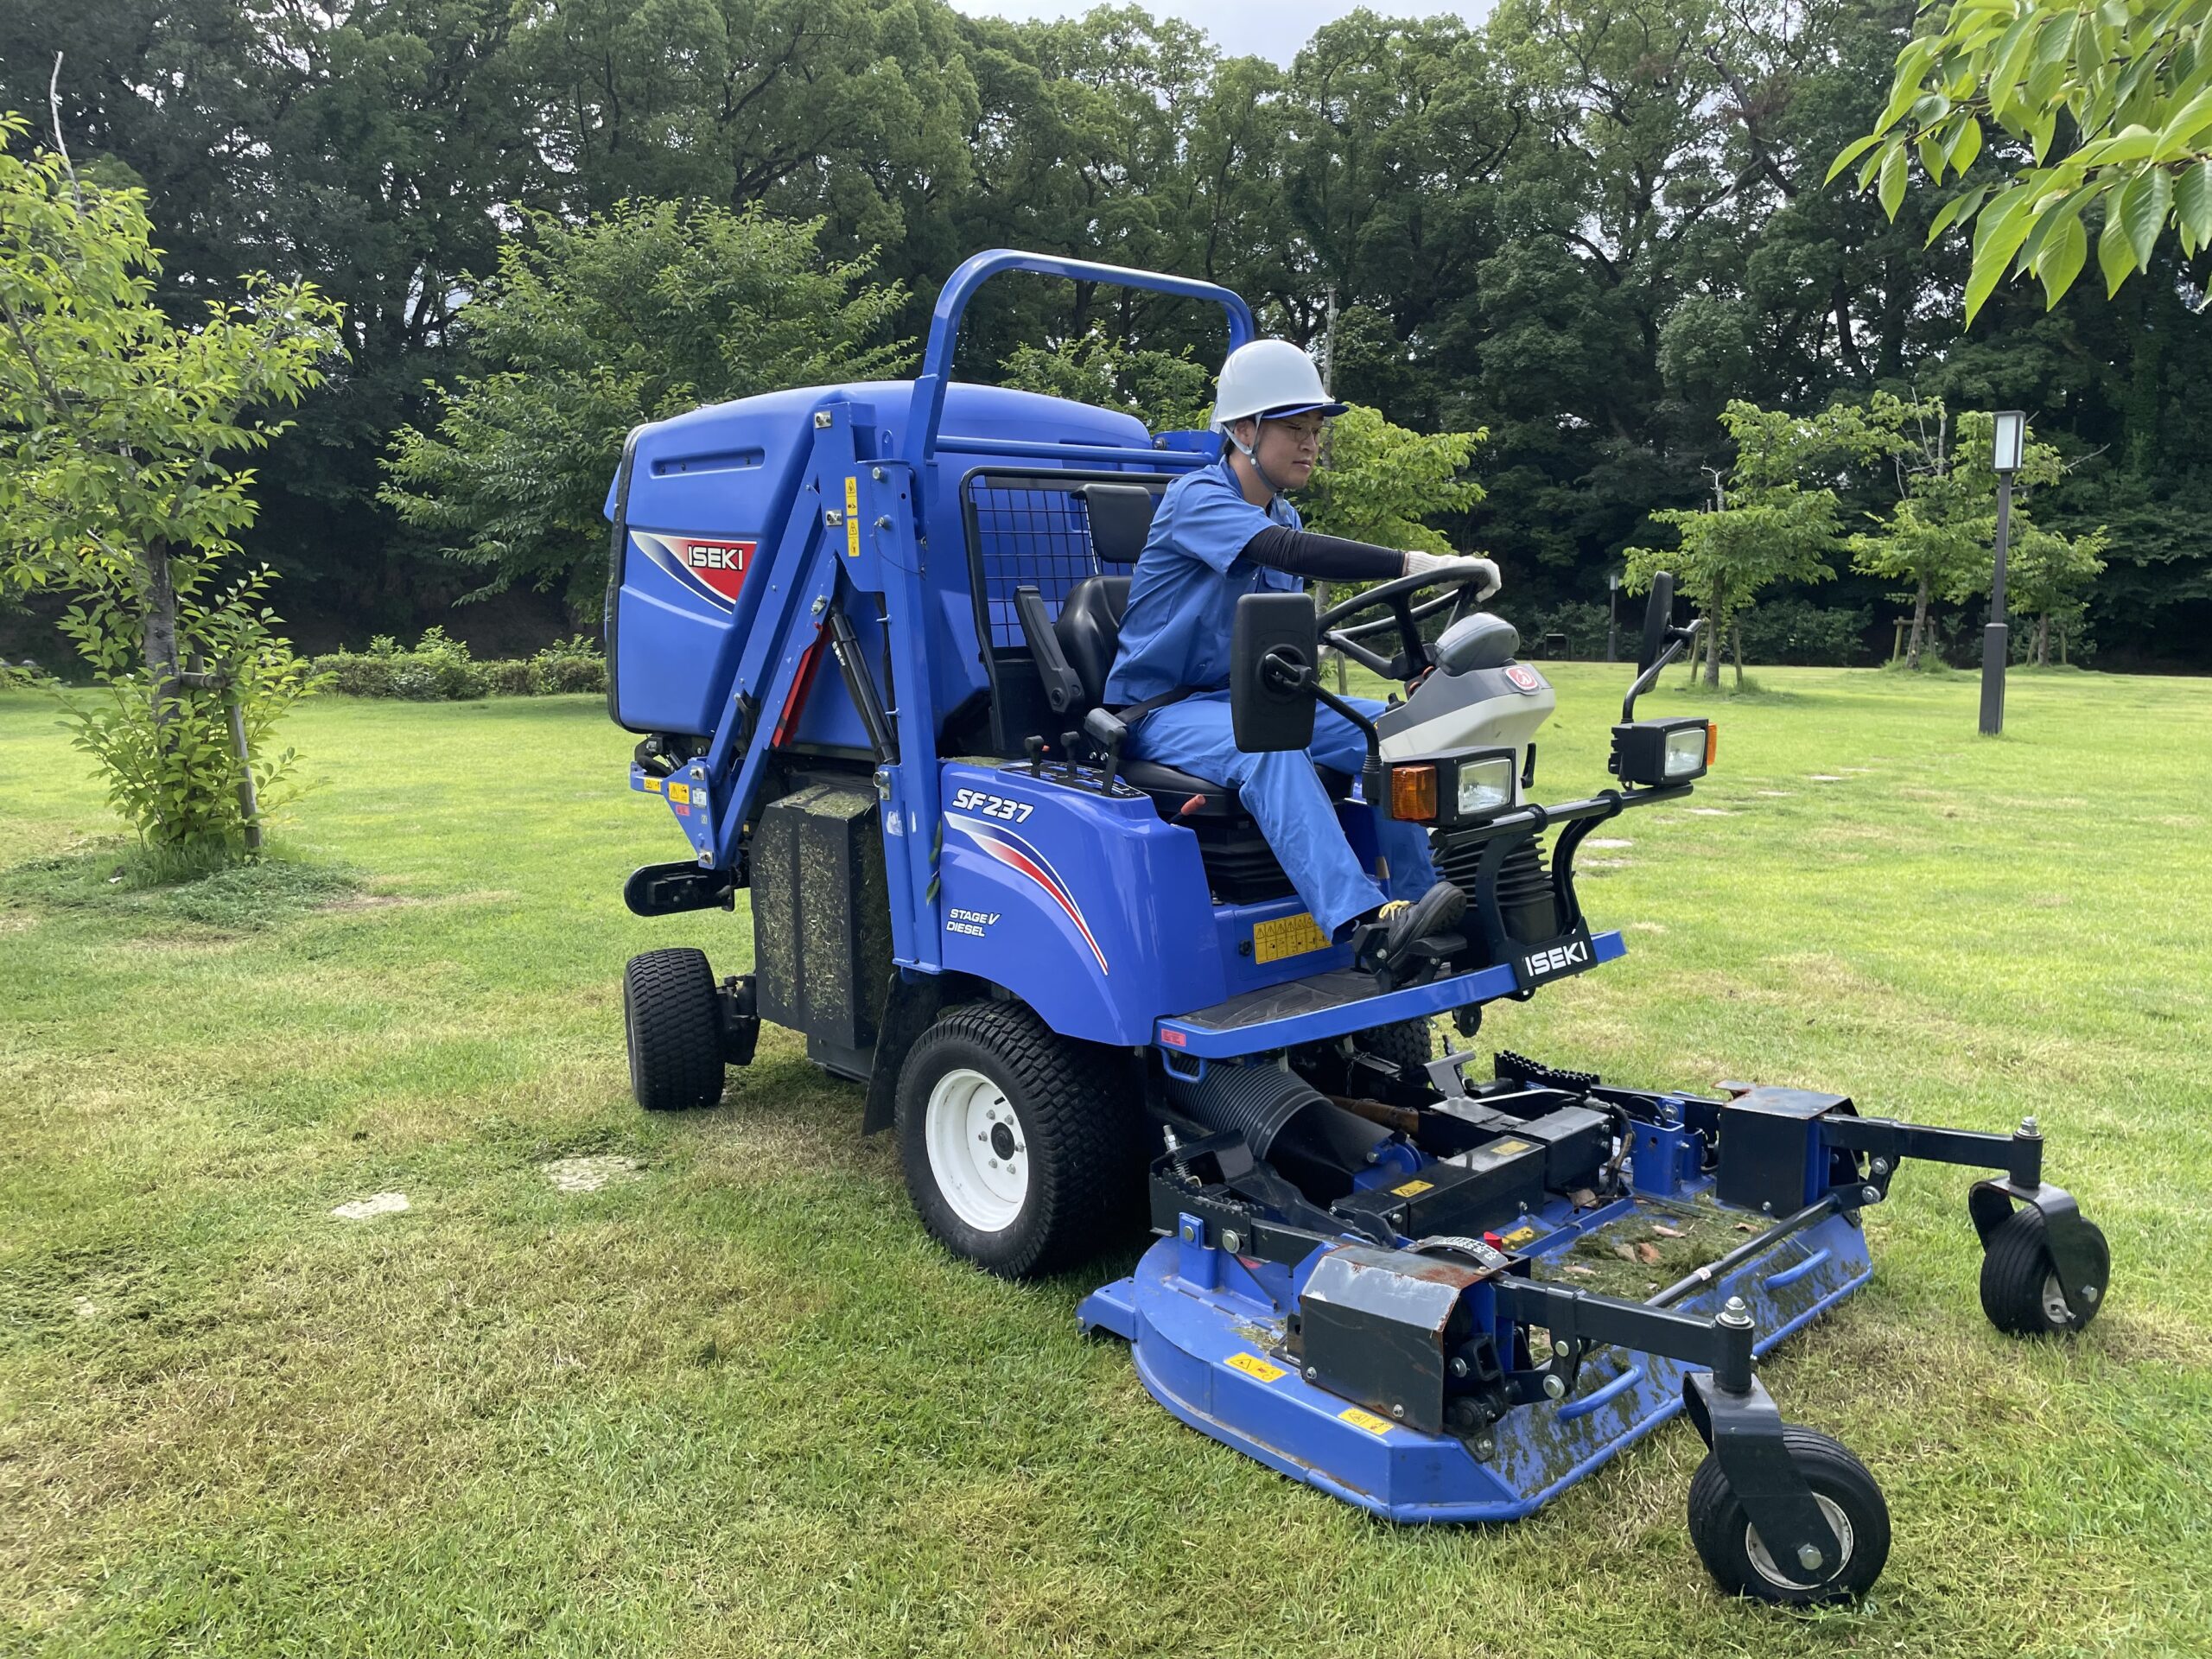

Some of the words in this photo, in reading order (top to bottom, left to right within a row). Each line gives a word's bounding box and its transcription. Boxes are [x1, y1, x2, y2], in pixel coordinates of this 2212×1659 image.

[688, 545, 743, 570] ISEKI
[951, 787, 1035, 823] SF237
[946, 920, 985, 938] DIESEL
[950, 908, 988, 924] STAGE
[988, 912, 1001, 925] V
[1524, 941, 1589, 977] ISEKI
